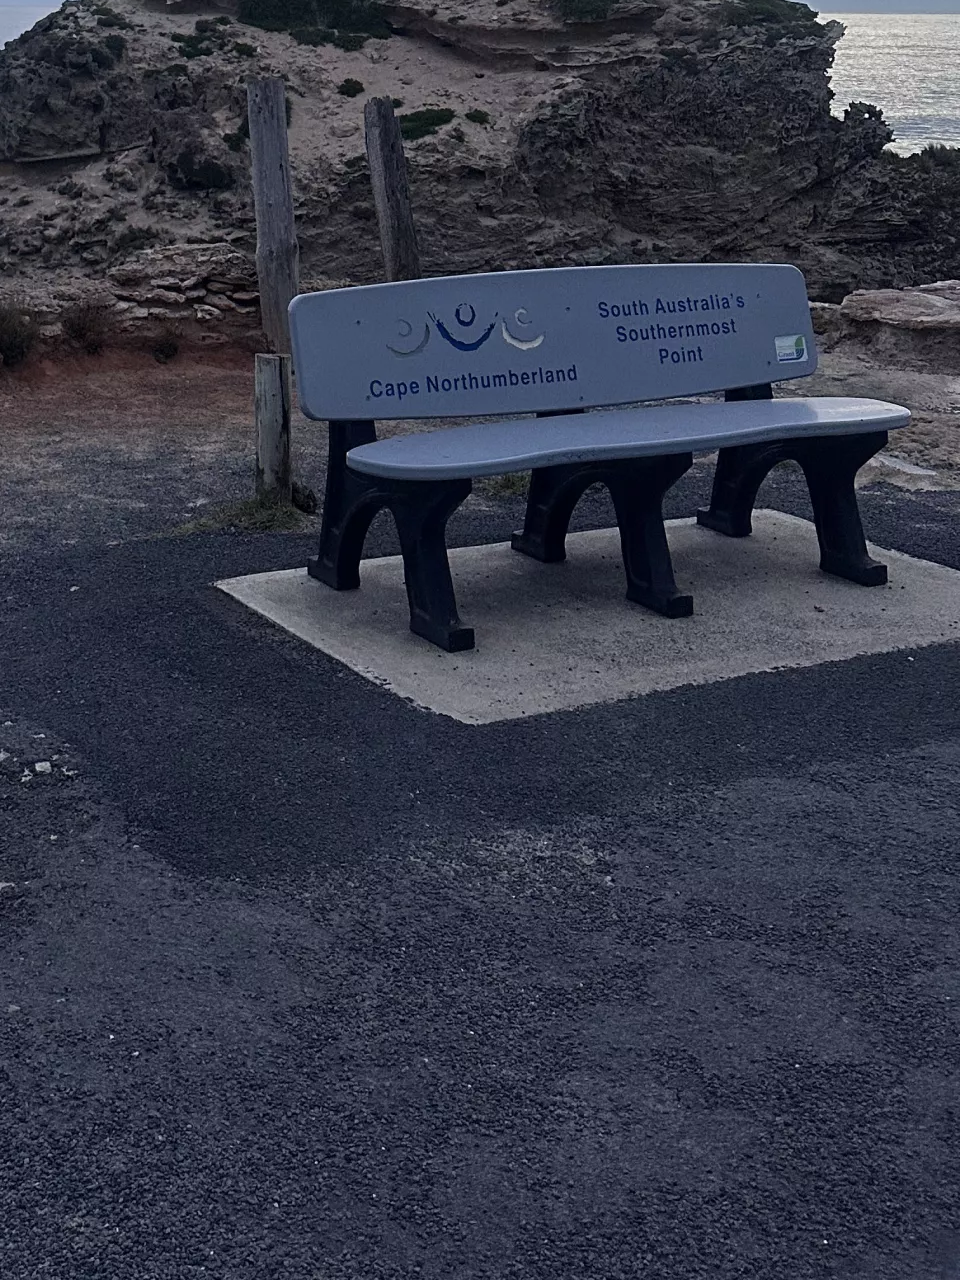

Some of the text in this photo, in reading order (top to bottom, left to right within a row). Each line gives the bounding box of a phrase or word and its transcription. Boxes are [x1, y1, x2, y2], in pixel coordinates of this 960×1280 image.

[598, 293, 745, 318] South Australia's
[616, 319, 737, 342] Southernmost
[659, 346, 703, 364] Point
[369, 364, 578, 400] Cape Northumberland
